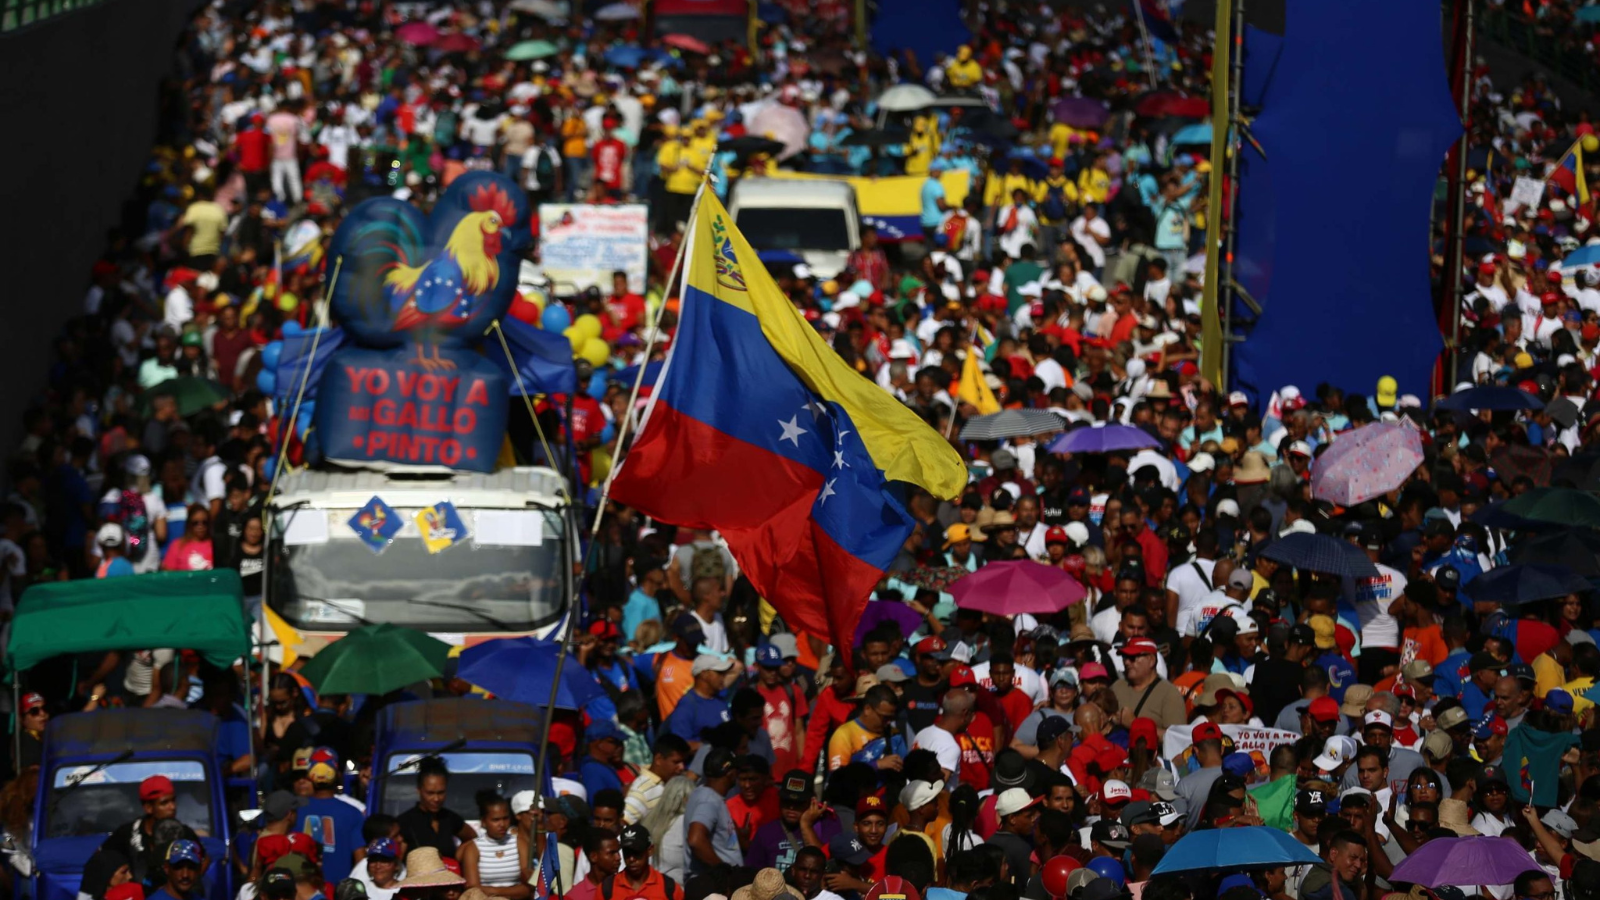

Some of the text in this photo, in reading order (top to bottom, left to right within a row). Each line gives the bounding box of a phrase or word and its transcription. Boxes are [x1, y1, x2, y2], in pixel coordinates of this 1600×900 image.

[345, 366, 489, 406] YO VOY A
[372, 398, 477, 434] GALLO
[366, 430, 462, 466] PINTO
[1237, 731, 1250, 739] YO
[1253, 730, 1270, 739] VOY
